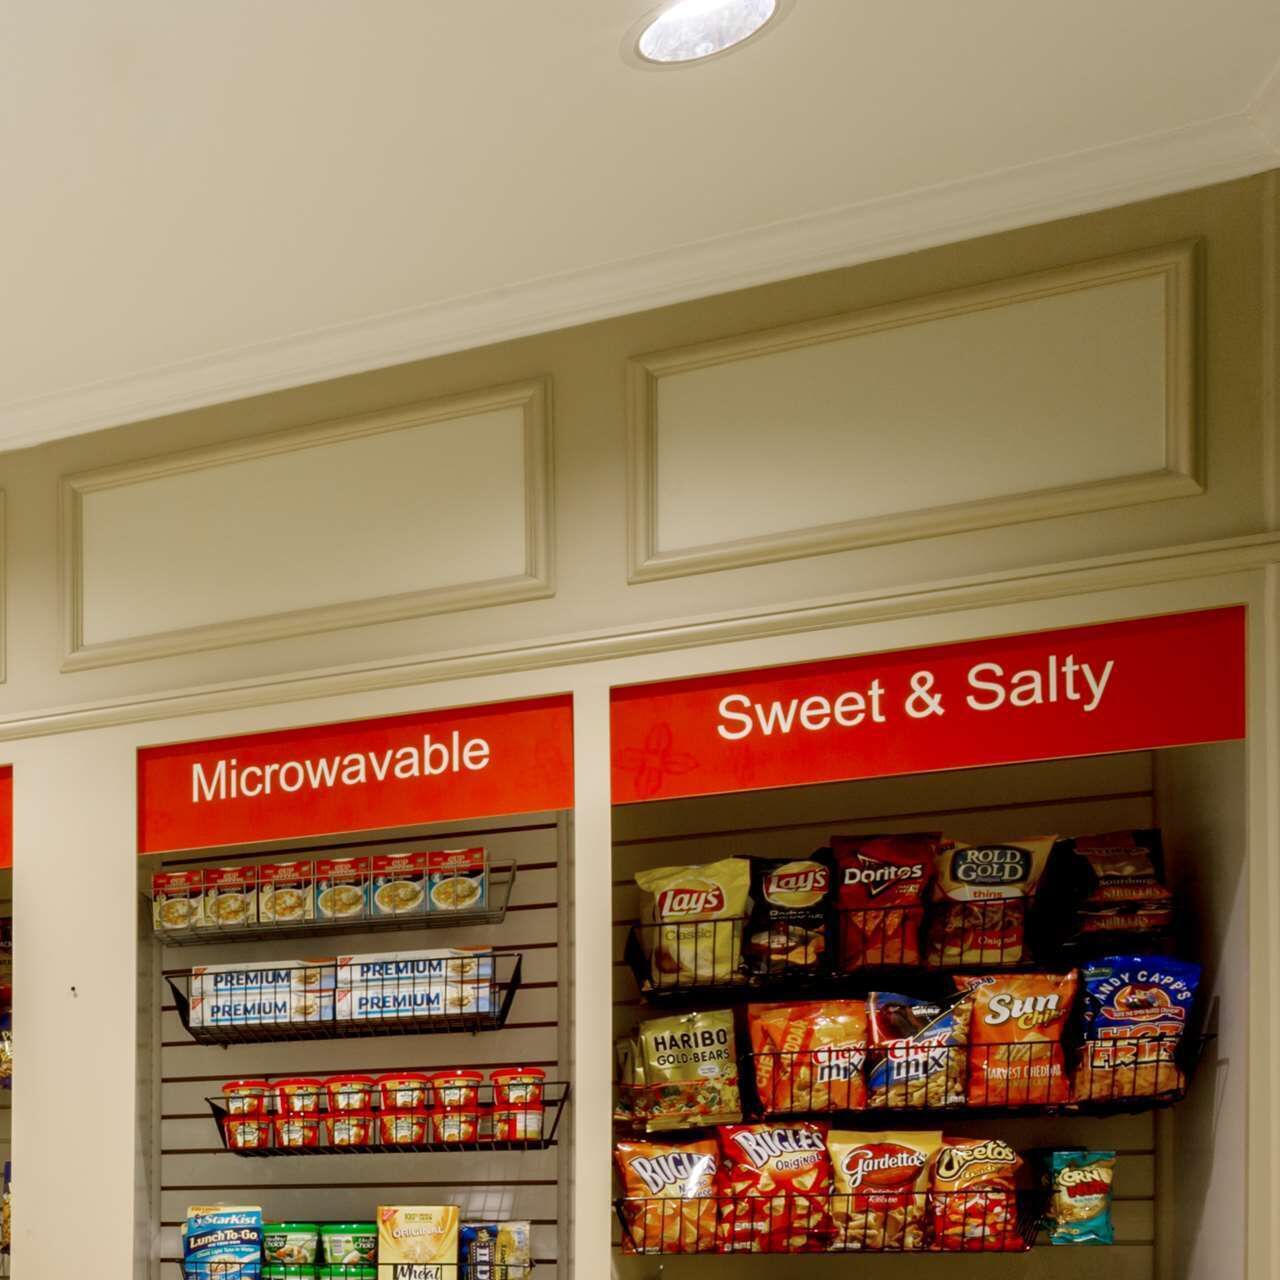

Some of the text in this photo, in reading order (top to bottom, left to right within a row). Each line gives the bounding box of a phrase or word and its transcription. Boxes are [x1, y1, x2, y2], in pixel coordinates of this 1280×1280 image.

[717, 654, 1115, 740] Sweet & Salty
[192, 731, 490, 802] Microwavable
[967, 850, 1021, 863] ROLD
[769, 866, 828, 894] Lay's
[844, 864, 922, 885] Doritos
[957, 863, 1023, 880] GOLD
[662, 888, 720, 916] Lay's
[973, 890, 1003, 898] thins
[360, 959, 443, 977] PREMIUM
[213, 971, 291, 988] PREMIUM
[210, 1001, 288, 1018] PREMIUM
[358, 992, 441, 1010] PREMIUM
[985, 993, 1060, 1025] Sun
[654, 1028, 728, 1052] HARIBO
[890, 1033, 951, 1060] Chex
[657, 1049, 730, 1066] GOLD-BEARS
[812, 1041, 865, 1064] Chex
[818, 1061, 862, 1082] mix
[895, 1051, 946, 1078] mix
[734, 1128, 826, 1169] BUGLES
[939, 1140, 1016, 1178] Cheetos
[775, 1152, 822, 1171] Original
[842, 1149, 927, 1188] Gardetto's
[630, 1152, 717, 1195] BUGLES
[204, 1213, 257, 1225] StarKist
[392, 1226, 444, 1239] ORIGINAL
